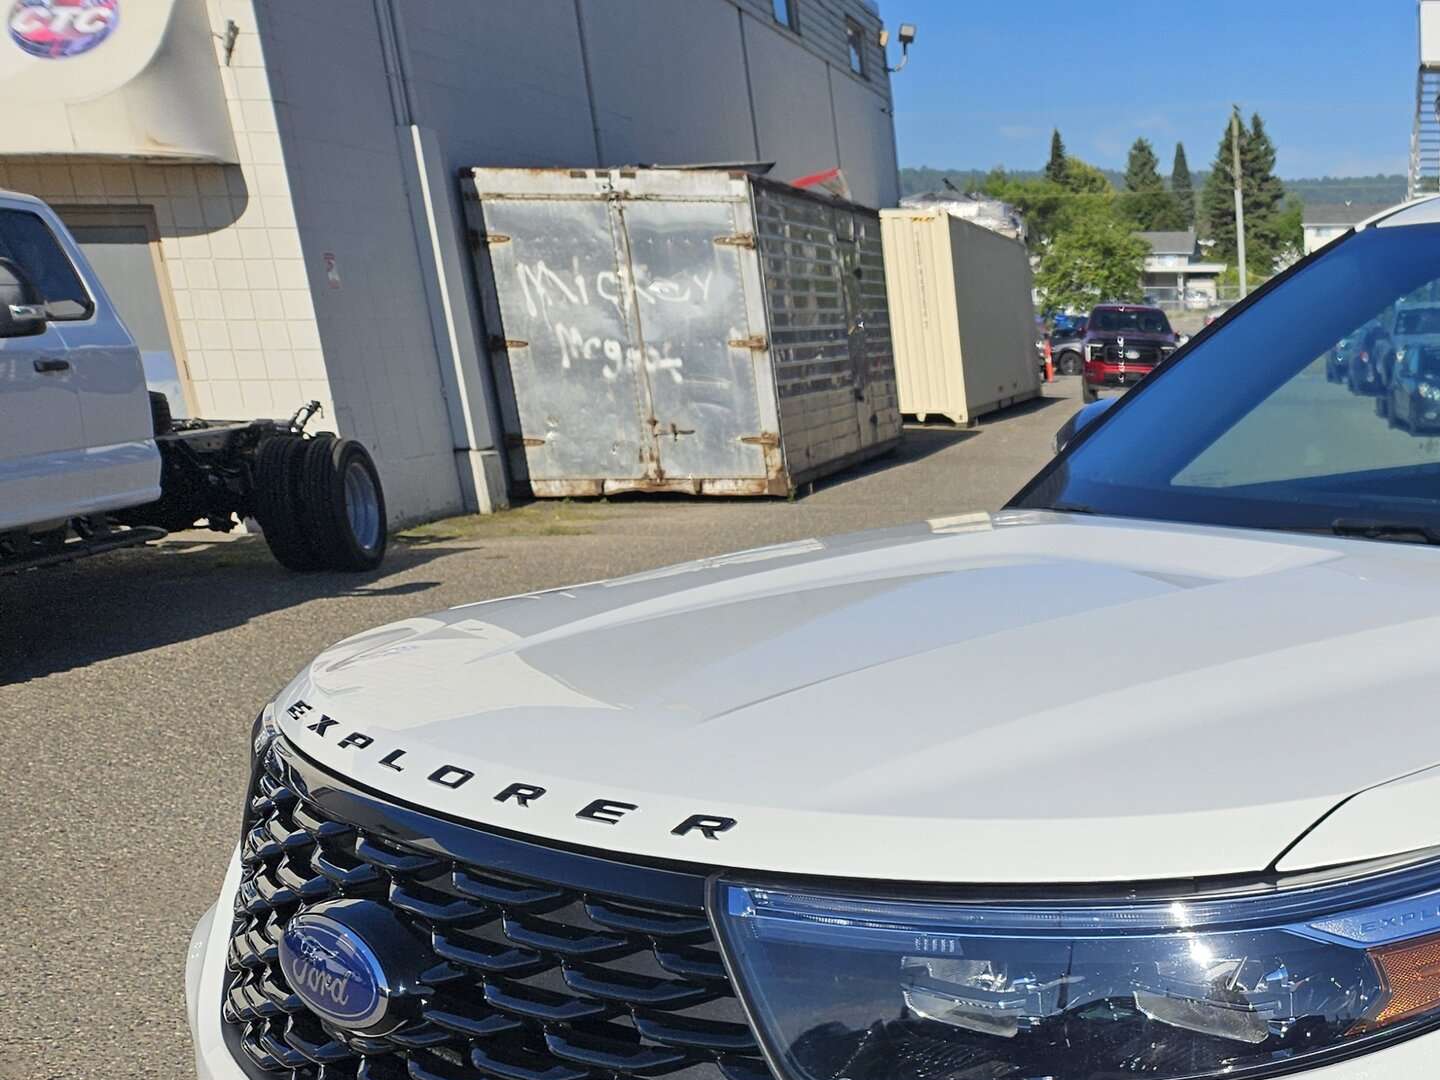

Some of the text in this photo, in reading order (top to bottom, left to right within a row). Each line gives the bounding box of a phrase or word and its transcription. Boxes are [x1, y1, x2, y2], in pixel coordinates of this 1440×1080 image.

[11, 5, 113, 33] CTC
[288, 700, 738, 841] EXPLORER
[292, 938, 352, 1005] Ford
